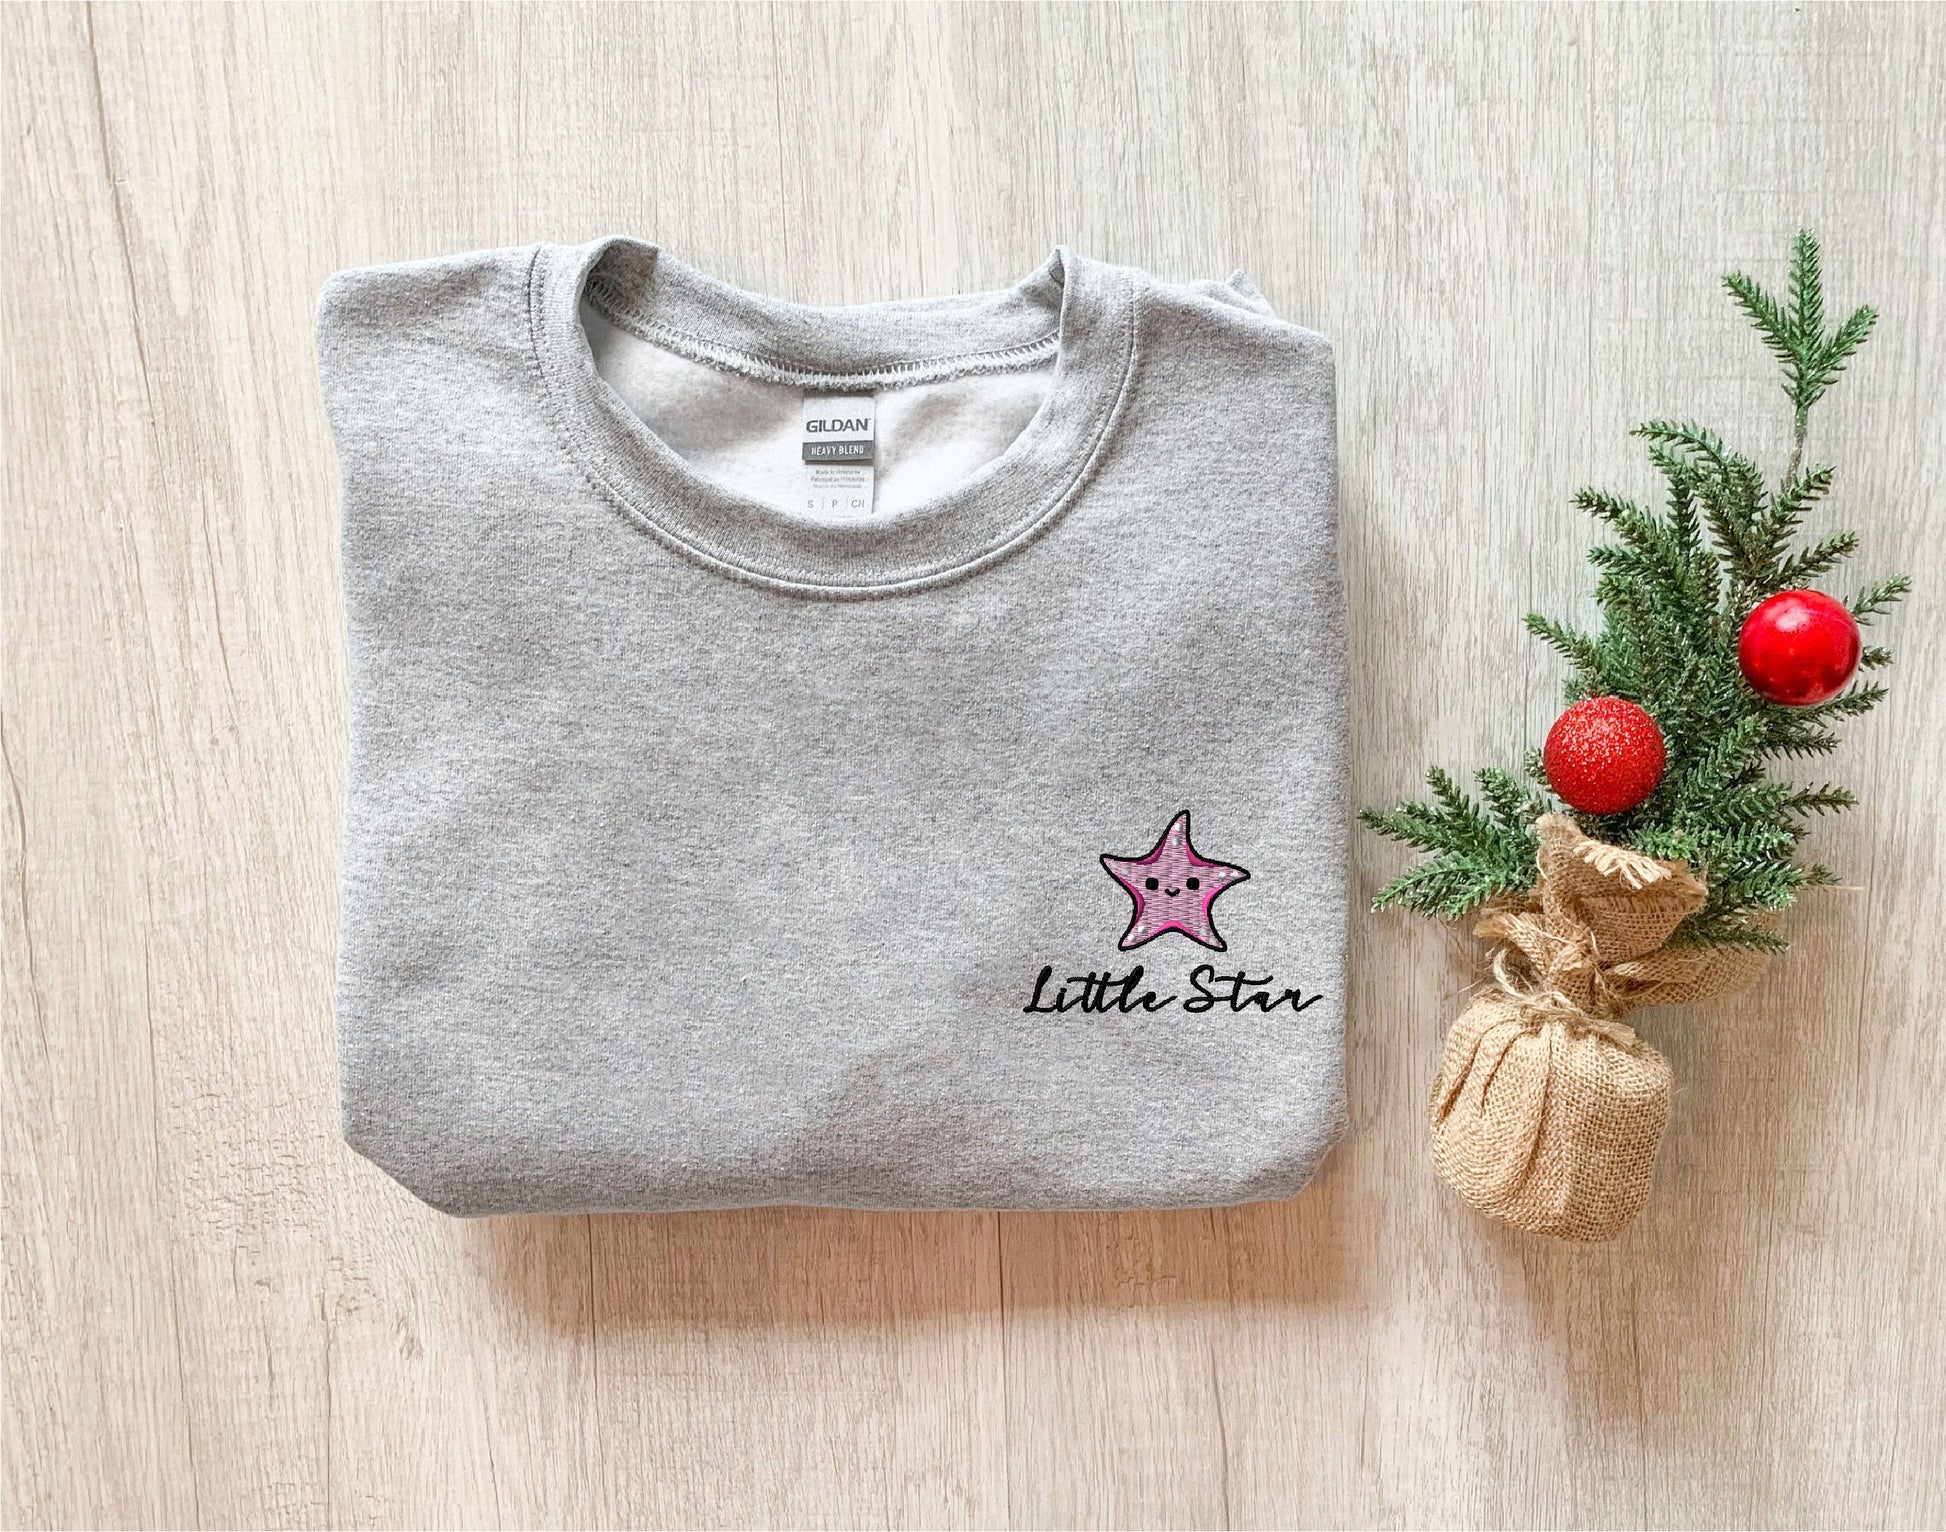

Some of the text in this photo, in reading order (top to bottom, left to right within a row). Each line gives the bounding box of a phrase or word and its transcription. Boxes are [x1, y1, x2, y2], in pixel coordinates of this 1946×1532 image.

[806, 418, 869, 433] GILDAN
[811, 444, 864, 456] HEAVY BLEND
[807, 499, 865, 508] S P CH
[1022, 964, 1324, 1014] Little Star
